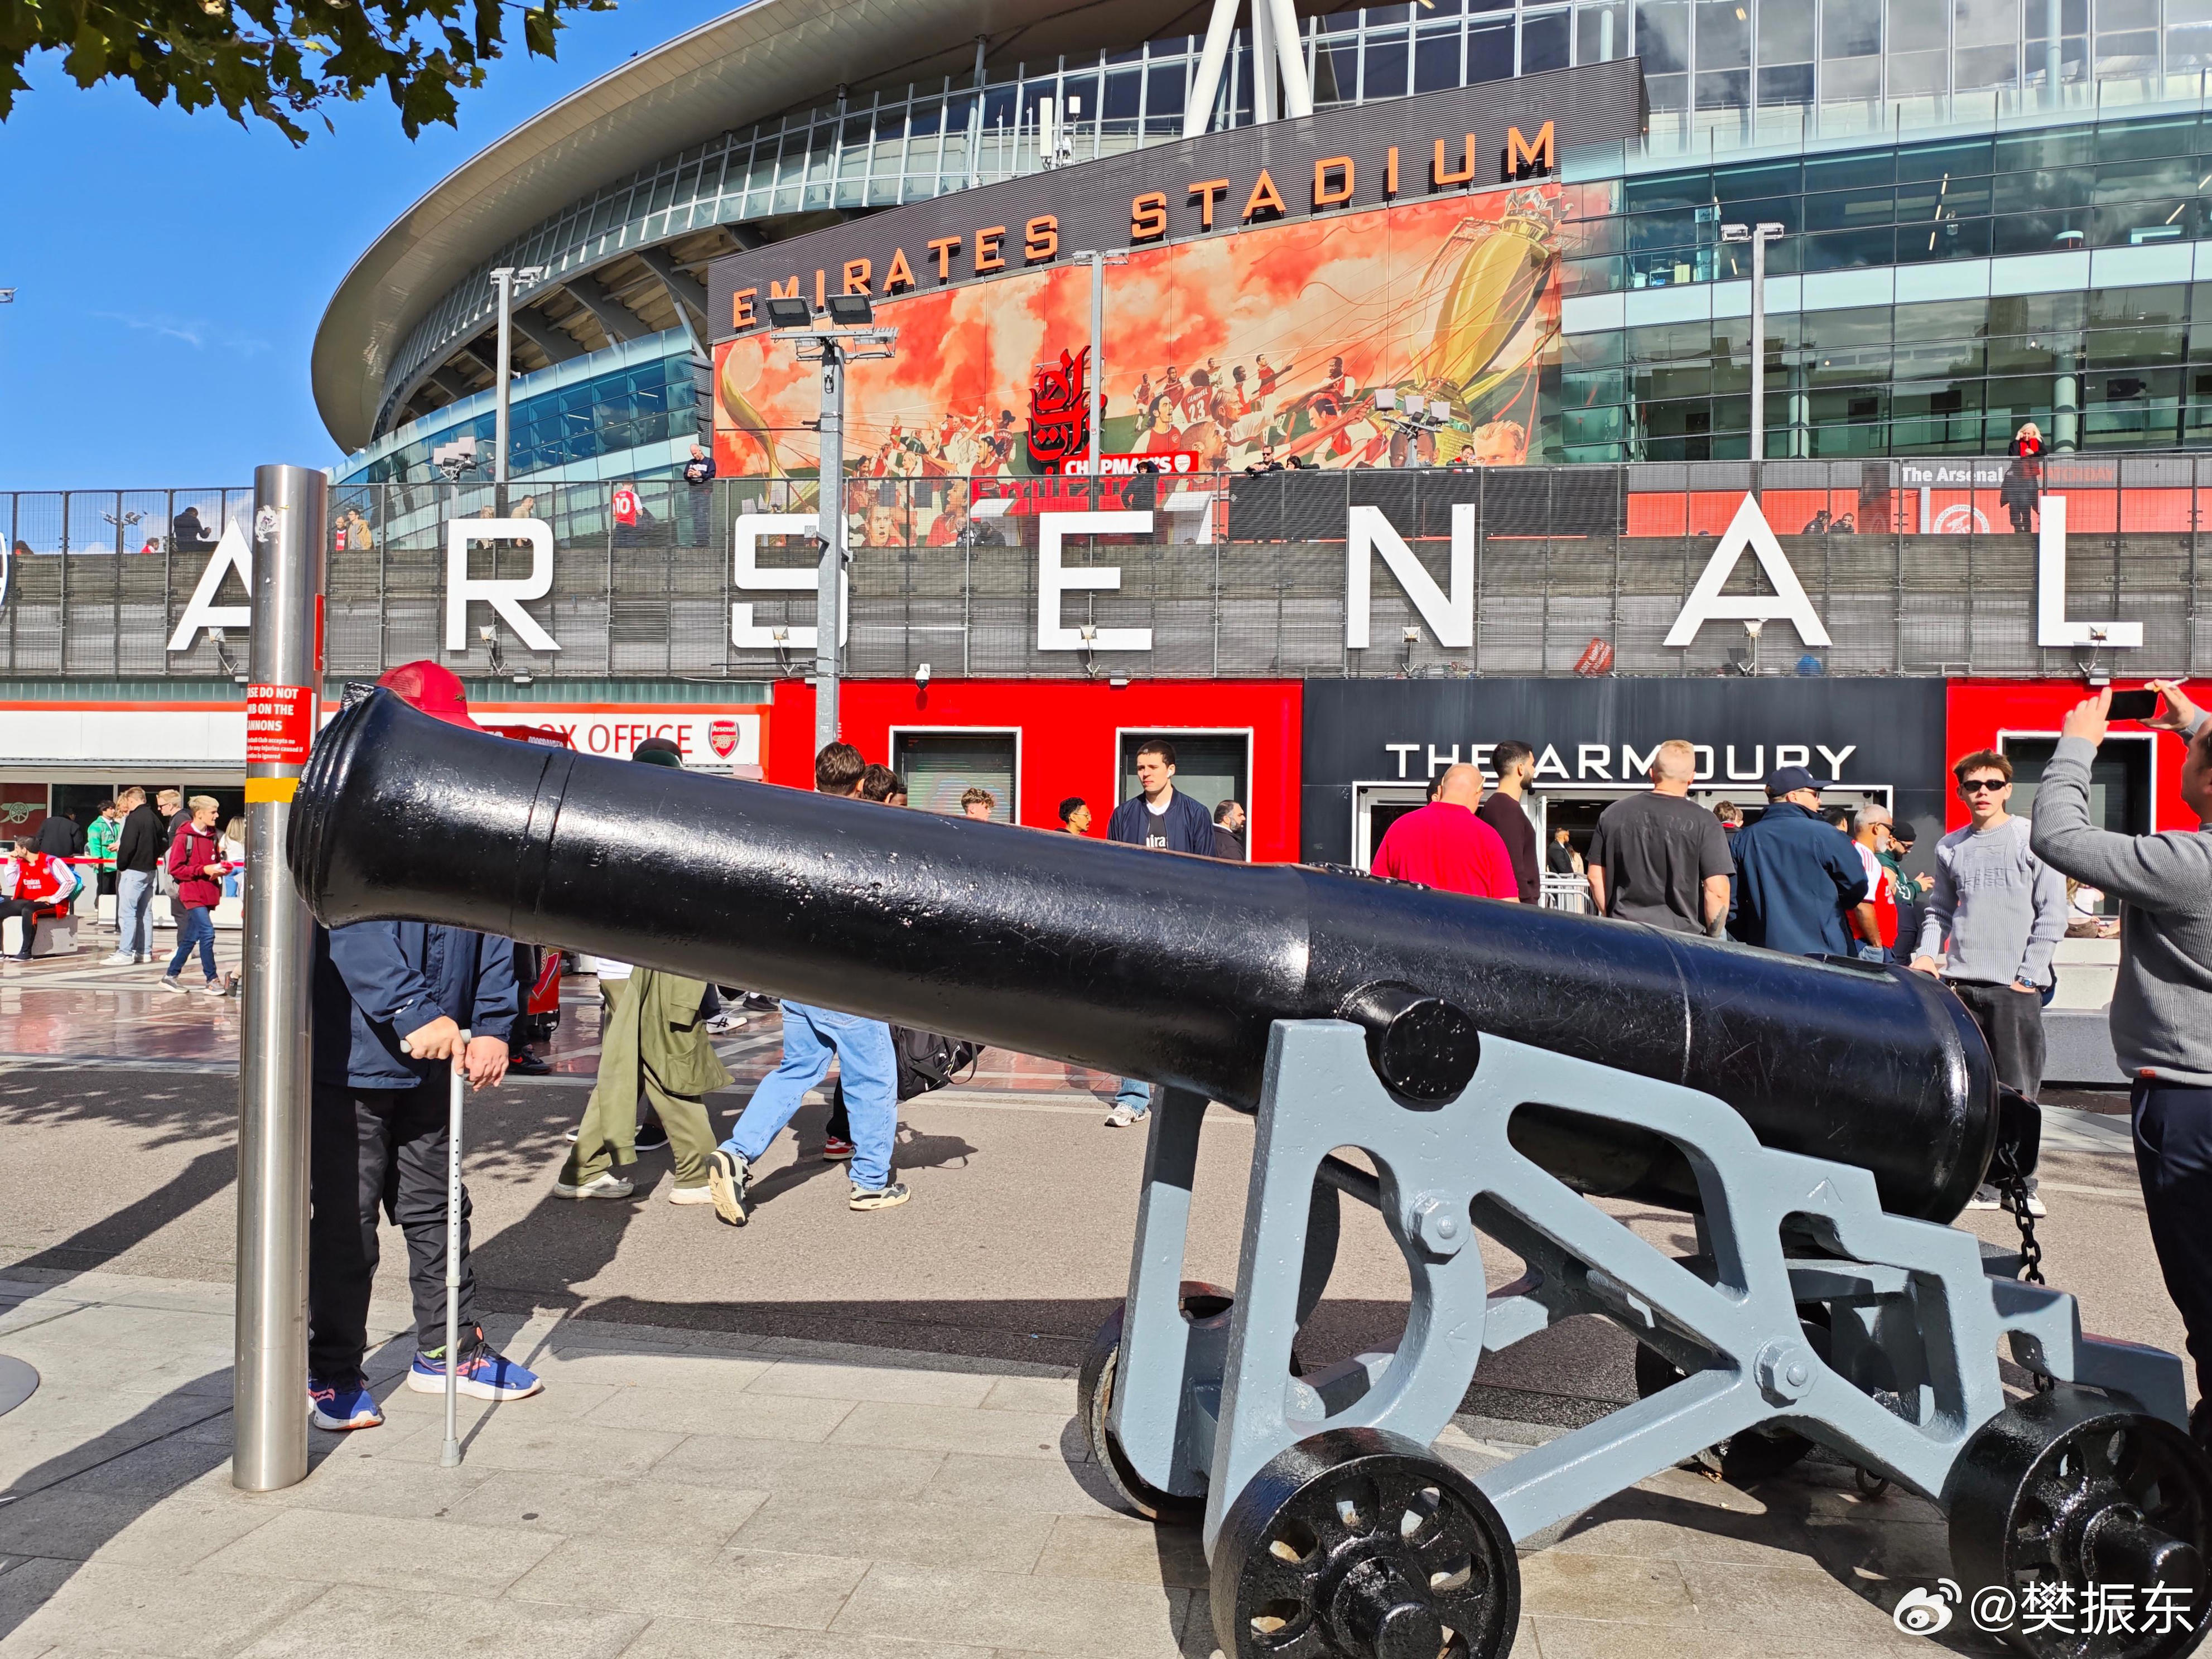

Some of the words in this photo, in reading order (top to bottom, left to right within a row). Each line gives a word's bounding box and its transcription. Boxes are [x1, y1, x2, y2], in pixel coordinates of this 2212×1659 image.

[732, 215, 1058, 328] EMIRATES
[1131, 120, 1554, 239] STADIUM
[1188, 399, 1206, 423] 23
[1064, 456, 1172, 475] CHPMA'S
[1902, 466, 1933, 482] The
[1935, 466, 2004, 483] Arsenal
[615, 497, 630, 514] 10
[167, 490, 2144, 652] ARSENAL
[259, 687, 273, 698] DO
[276, 687, 299, 700] NOT
[258, 703, 272, 715] ON
[274, 704, 294, 716] THE
[1385, 744, 1498, 779] THE
[1534, 744, 1857, 781] ARMOURY
